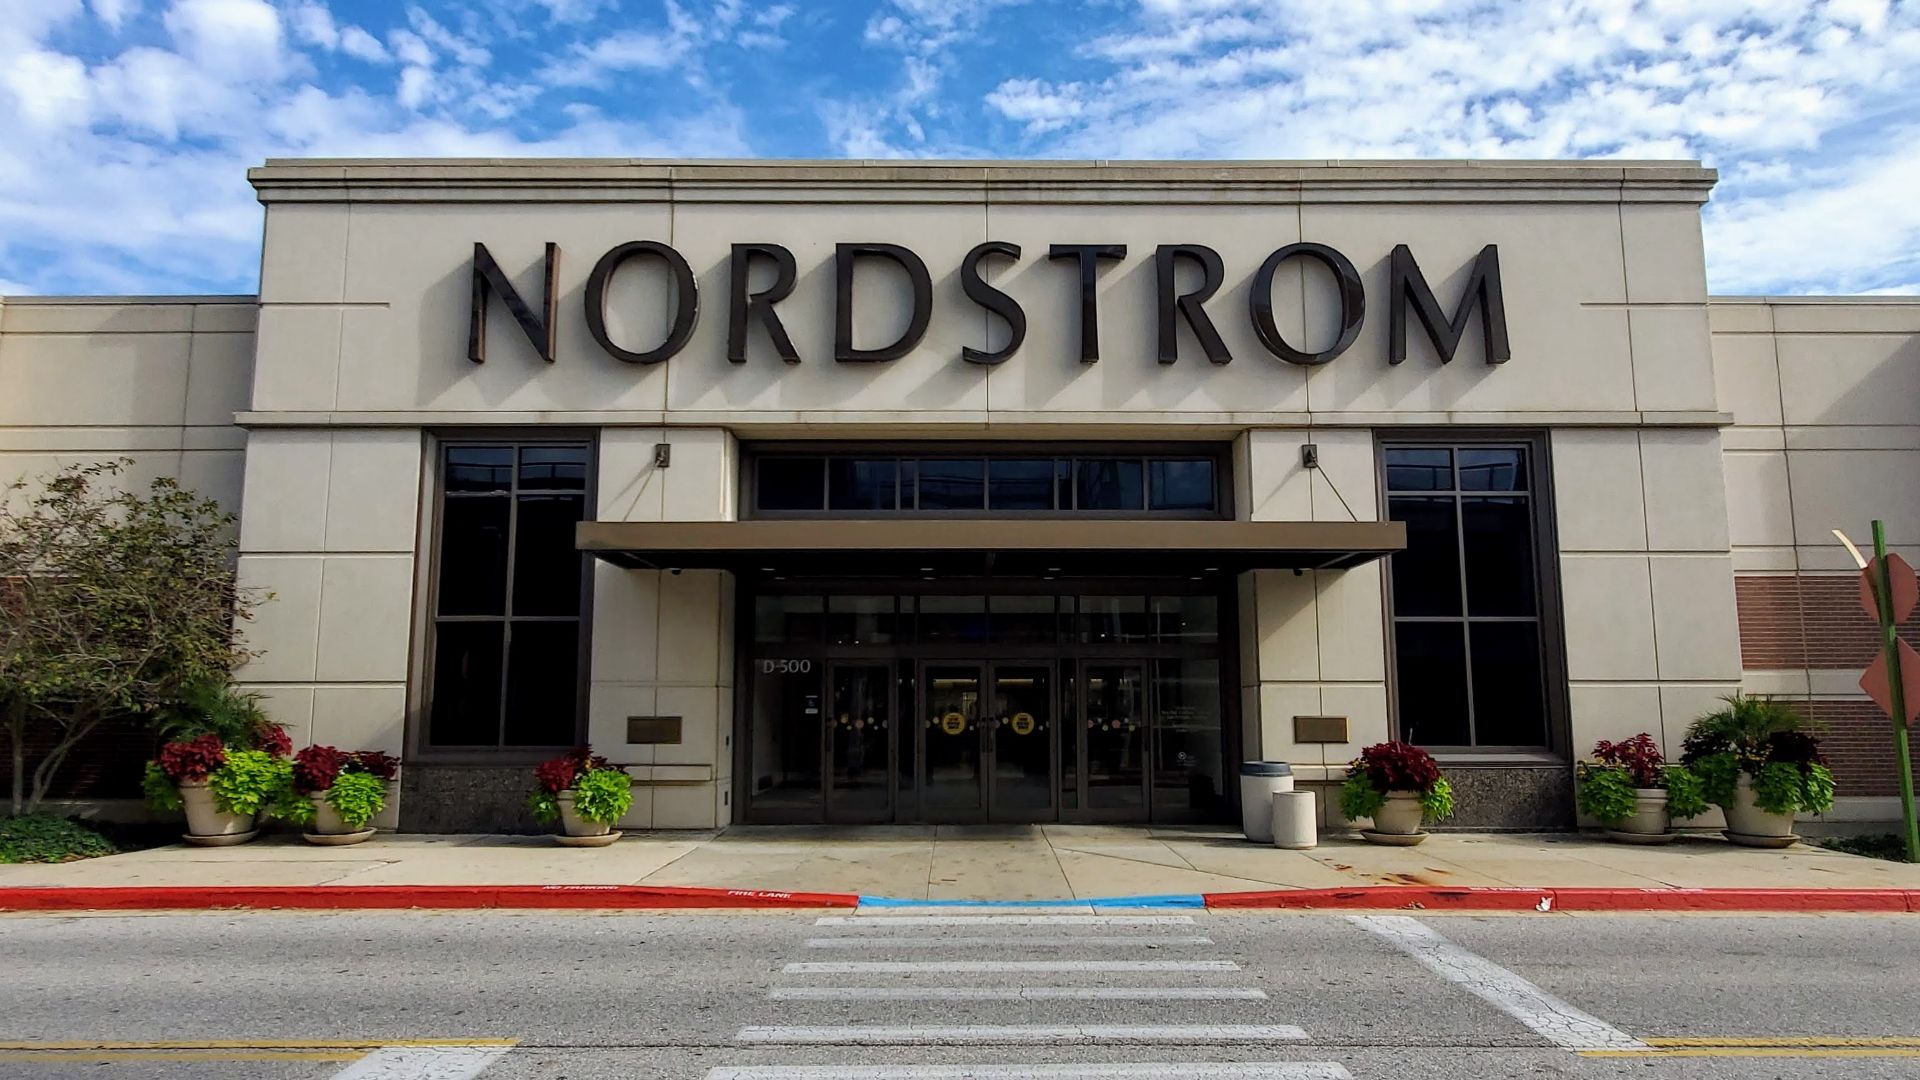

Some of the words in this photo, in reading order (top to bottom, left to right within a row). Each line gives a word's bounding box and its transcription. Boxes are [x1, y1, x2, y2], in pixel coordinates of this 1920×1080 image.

[467, 241, 1512, 364] NORDSTROM
[763, 659, 811, 673] D-500
[758, 891, 792, 899] LANE
